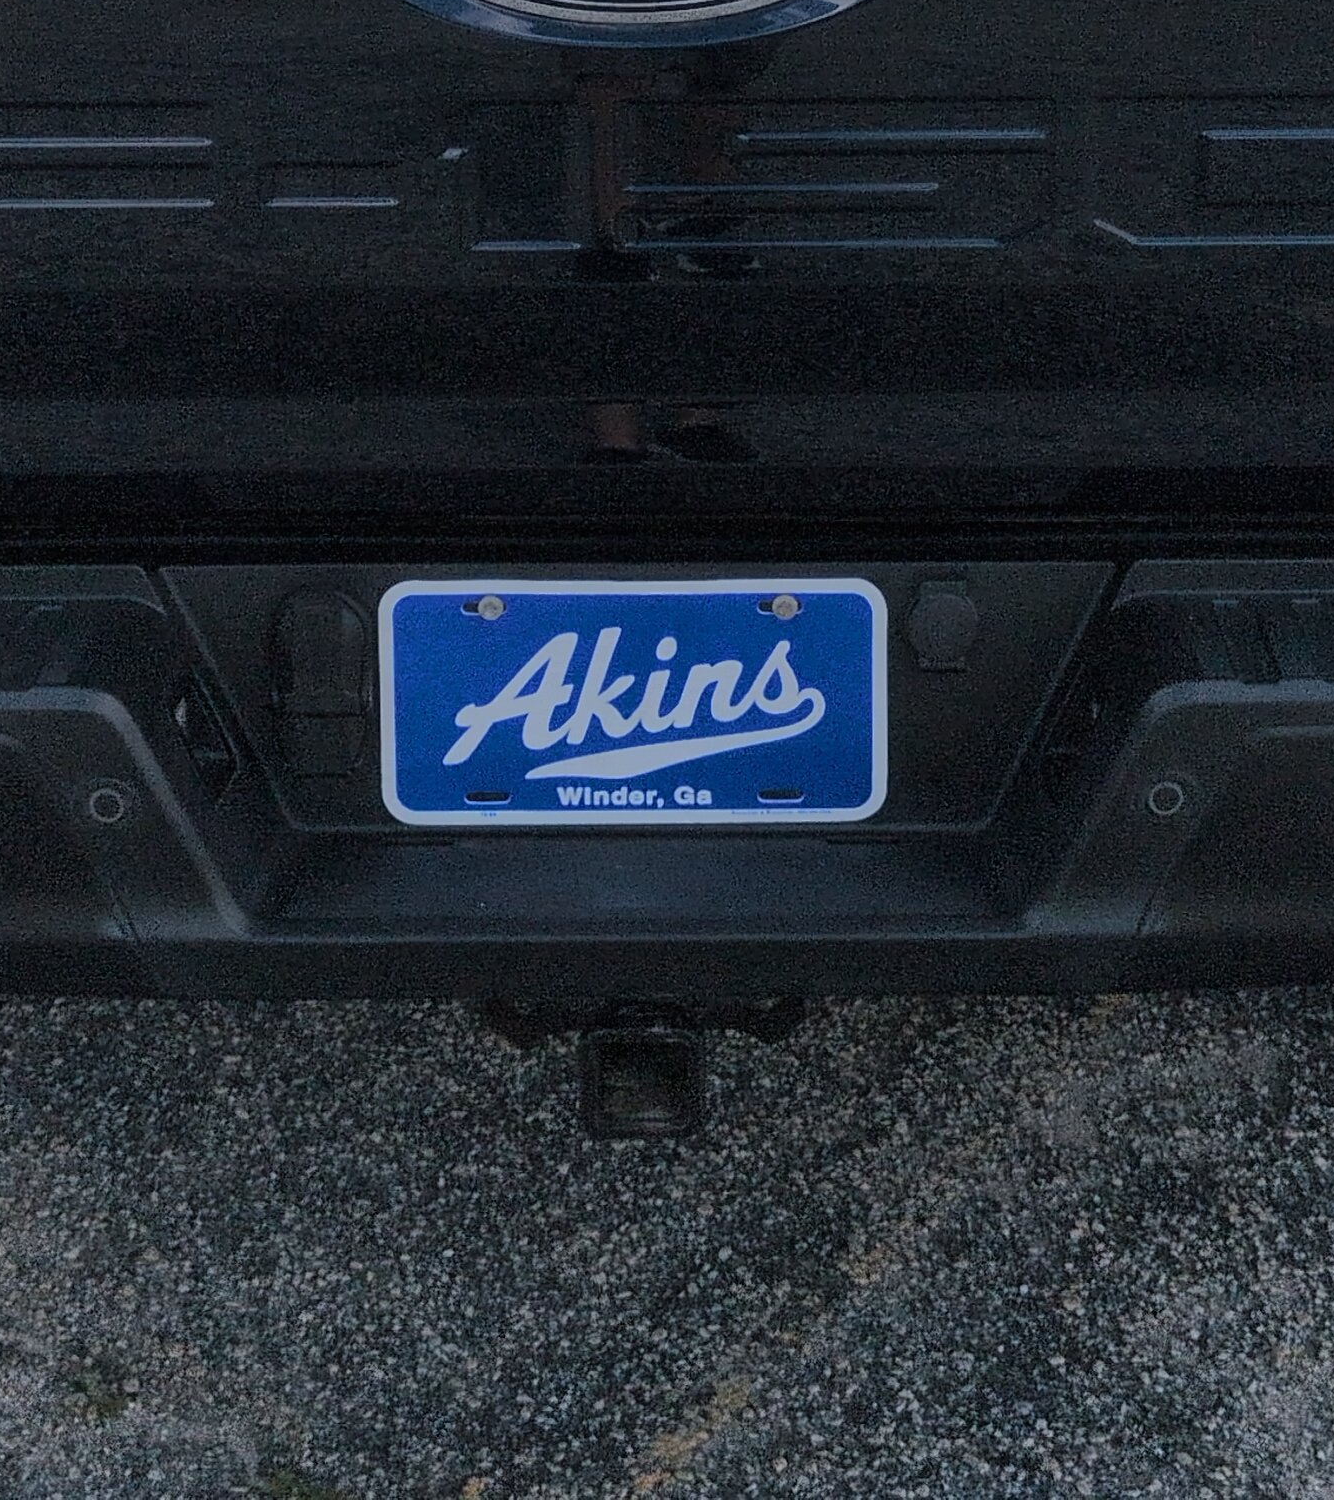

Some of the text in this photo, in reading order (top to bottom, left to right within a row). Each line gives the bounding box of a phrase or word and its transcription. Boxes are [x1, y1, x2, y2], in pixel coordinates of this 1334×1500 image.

[443, 627, 819, 766] Akins
[556, 786, 713, 808] Winder, Ga
